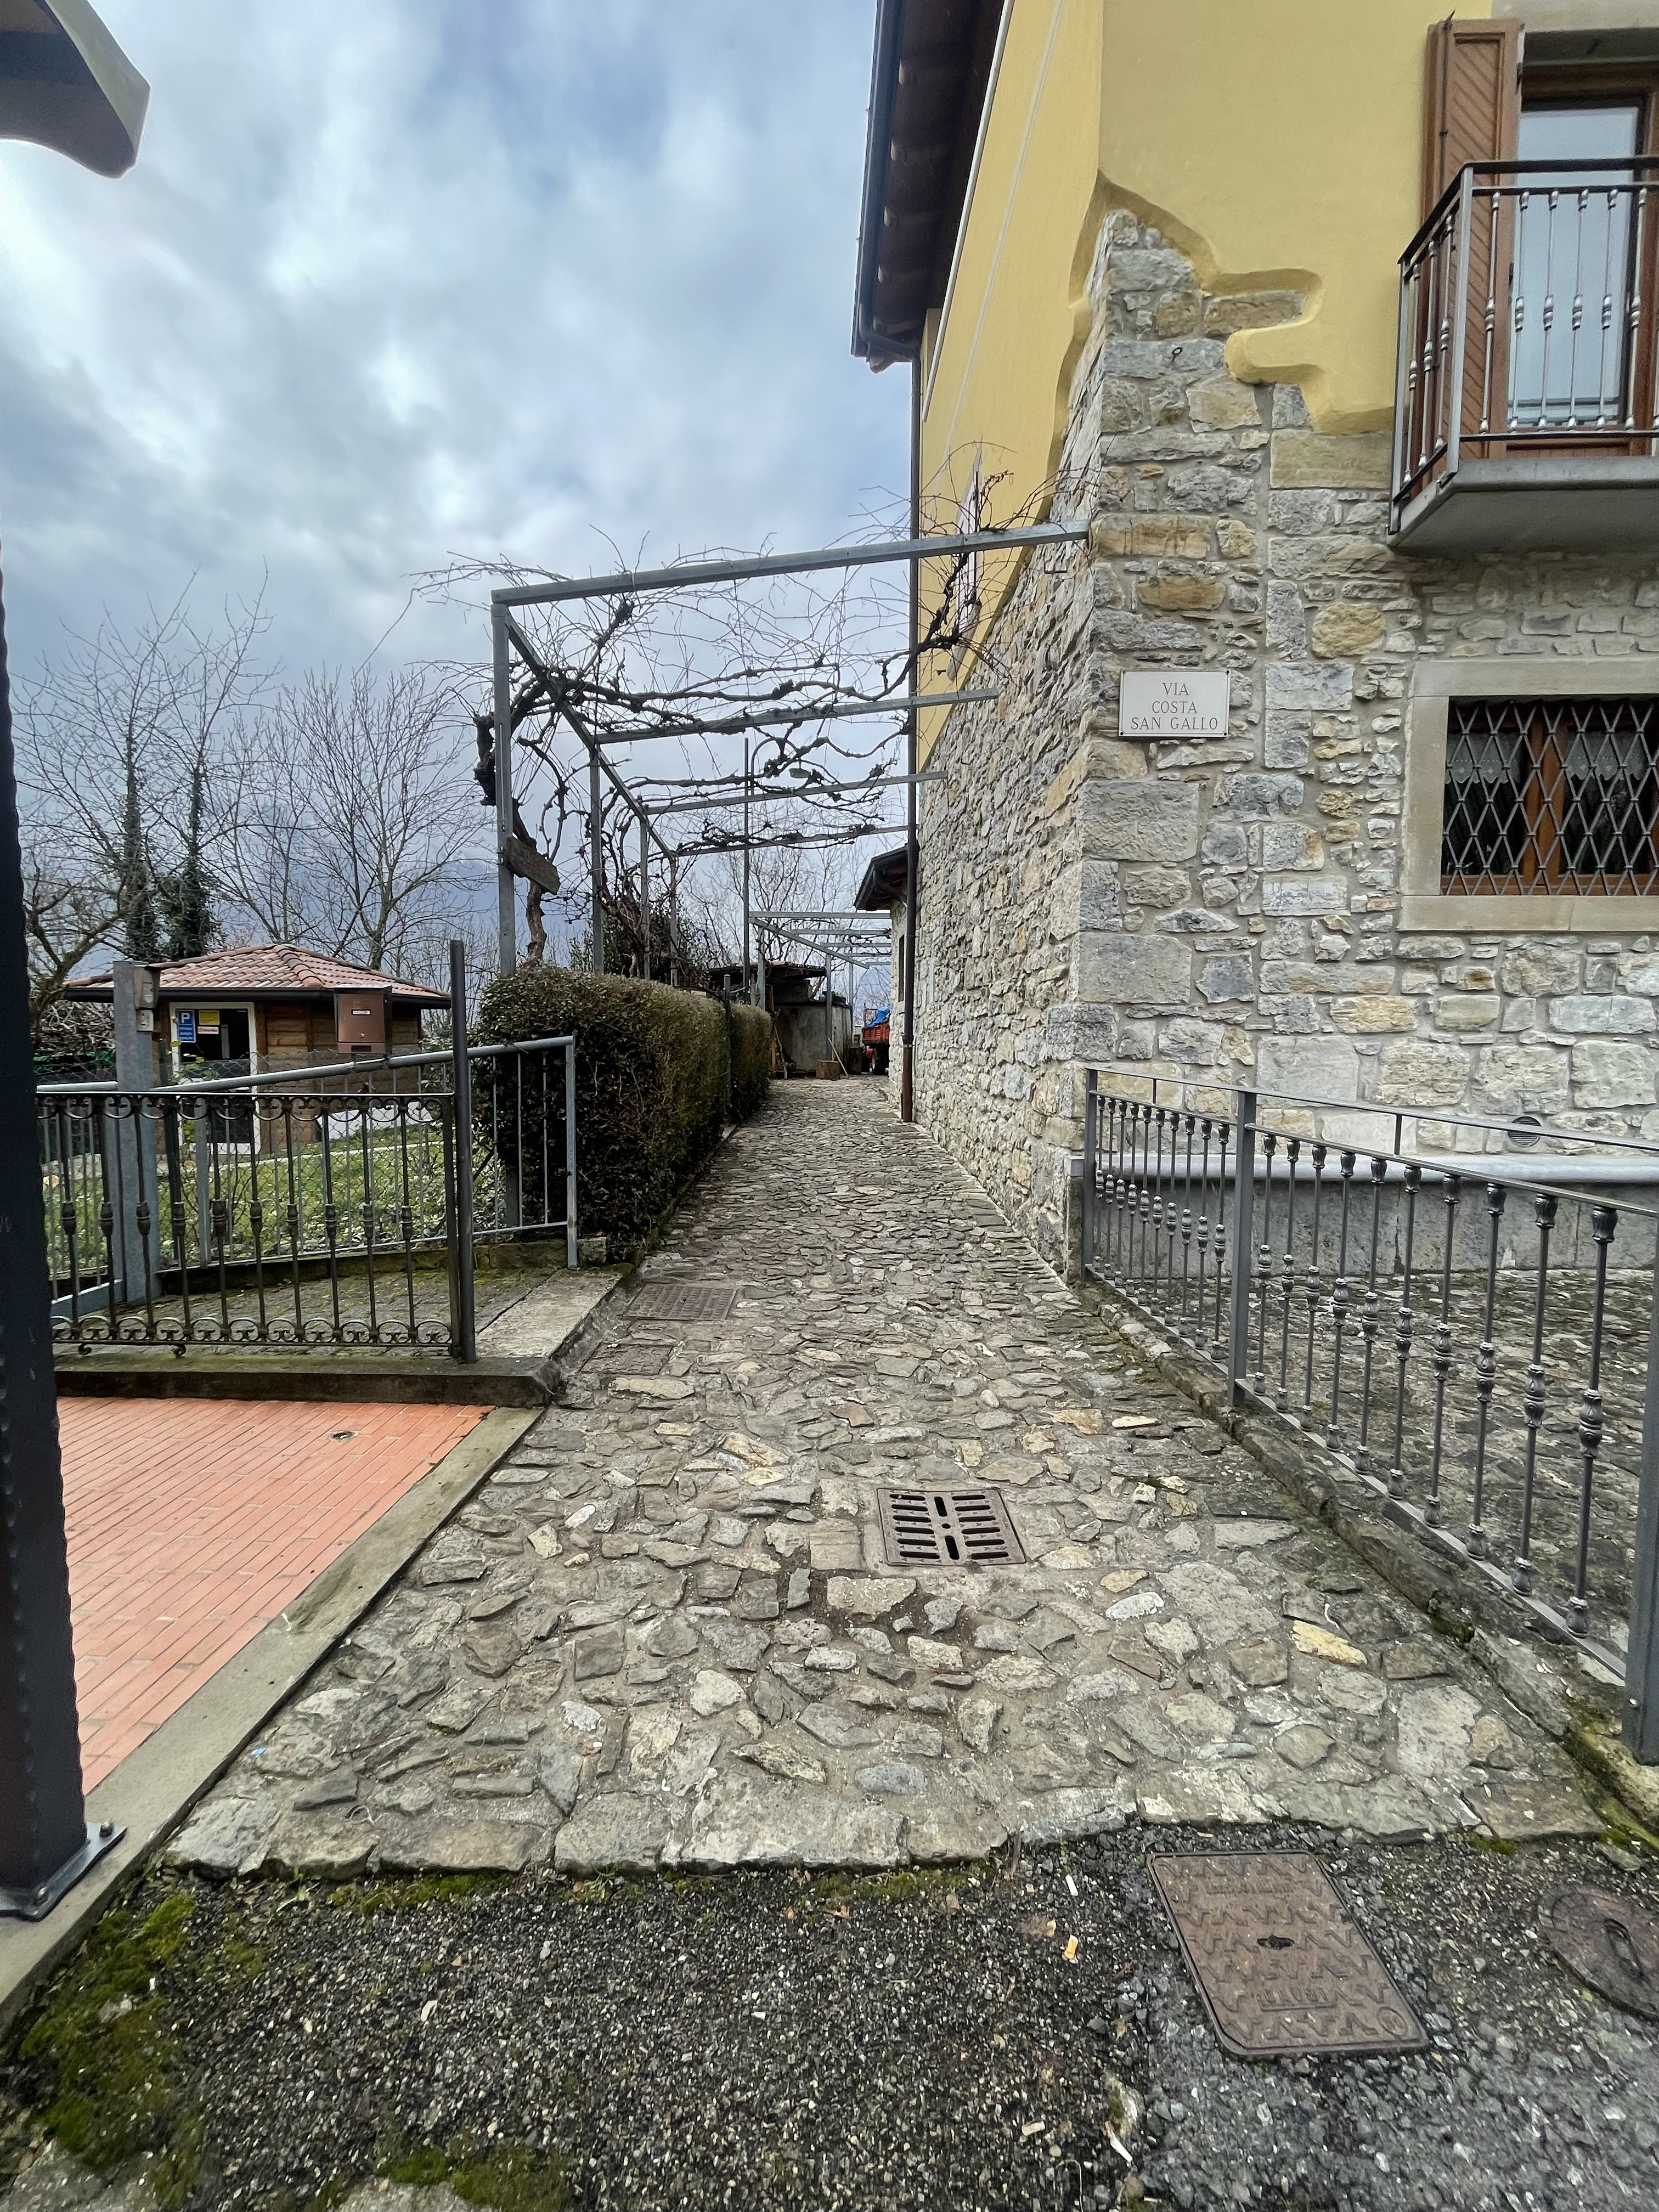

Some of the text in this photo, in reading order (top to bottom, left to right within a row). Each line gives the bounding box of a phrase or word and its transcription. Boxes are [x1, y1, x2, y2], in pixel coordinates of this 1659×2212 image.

[1163, 682, 1189, 696] VIA
[1152, 701, 1198, 714] COSTA
[1131, 716, 1218, 730] SAN GALLO
[181, 1012, 190, 1024] P
